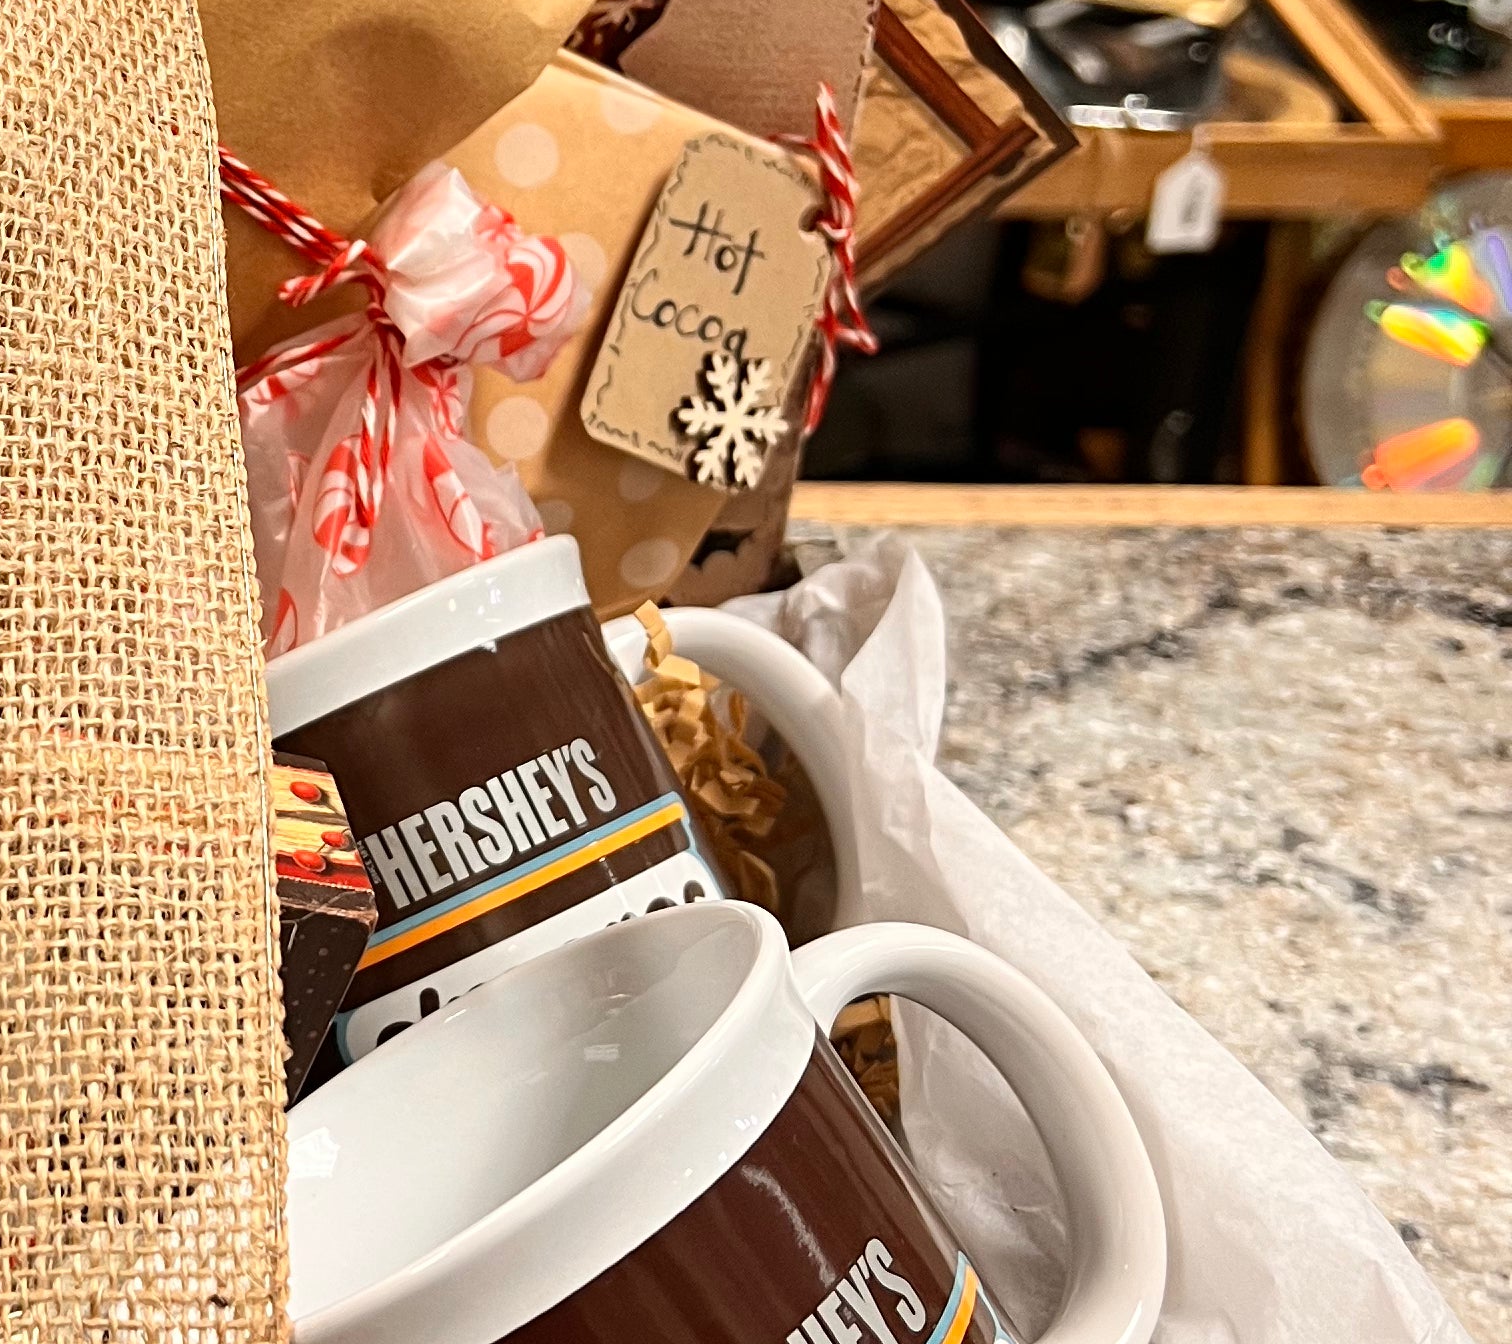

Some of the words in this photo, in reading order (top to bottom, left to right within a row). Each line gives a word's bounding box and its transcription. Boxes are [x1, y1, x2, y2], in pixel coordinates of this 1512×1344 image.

[668, 200, 768, 296] Hot
[631, 267, 748, 361] Cocoa
[363, 737, 618, 910] HERSHEY'S
